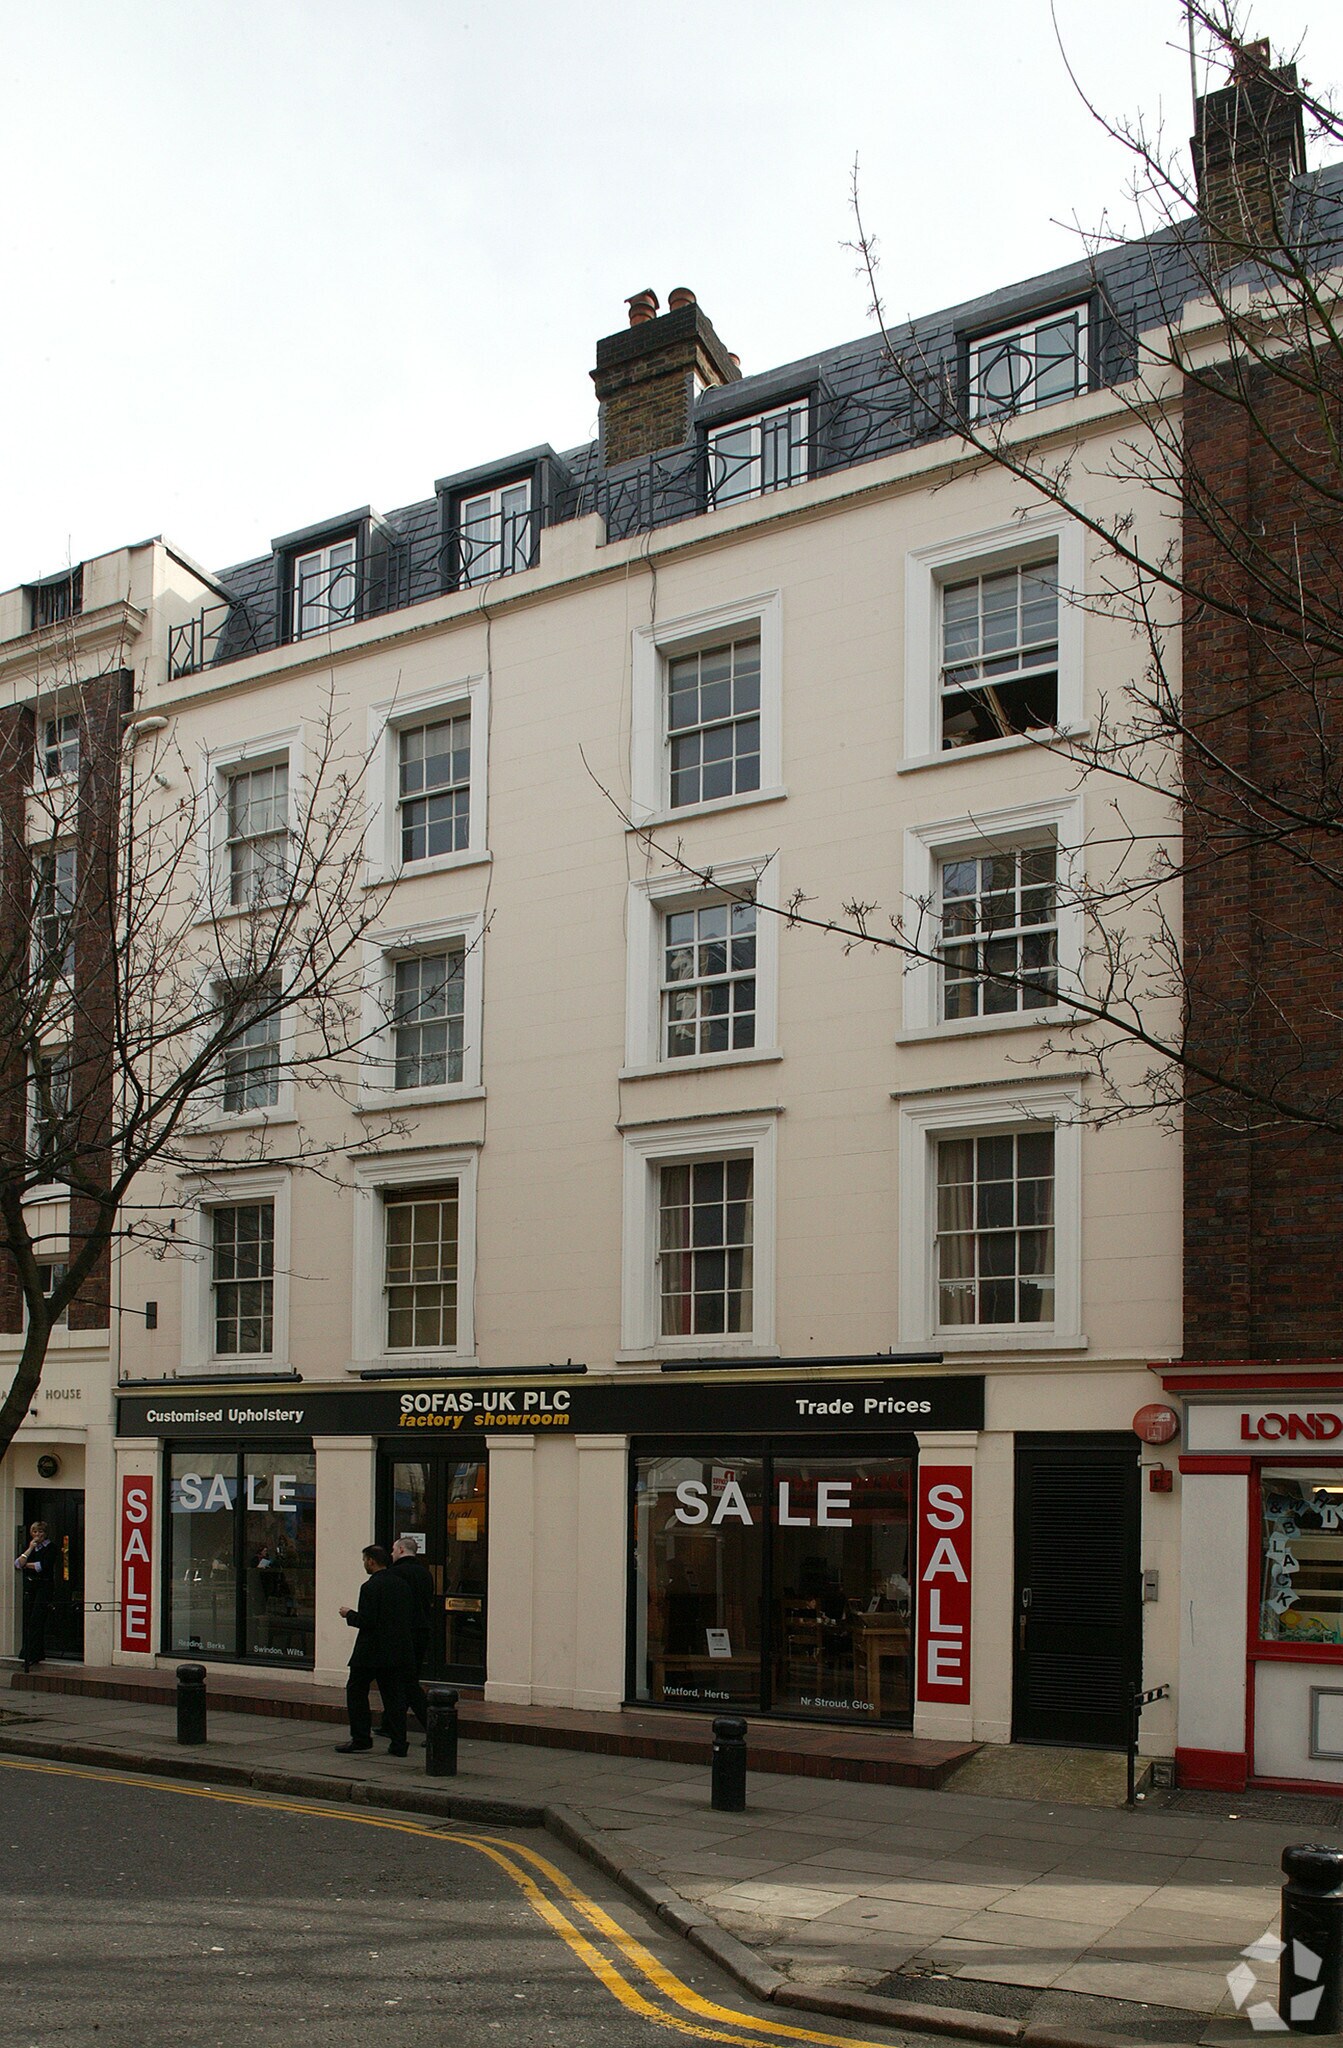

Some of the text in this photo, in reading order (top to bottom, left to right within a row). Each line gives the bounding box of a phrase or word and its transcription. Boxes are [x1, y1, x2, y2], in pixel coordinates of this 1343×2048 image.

[46, 1389, 82, 1400] HOUSE
[400, 1390, 571, 1413] SOFAS-UK PLC
[795, 1397, 932, 1415] Trade Prices
[146, 1408, 304, 1424] Customised Upholstery
[399, 1412, 570, 1429] factory showroom
[179, 1472, 297, 1512] SALE
[674, 1479, 853, 1528] SALE
[123, 1488, 150, 1639] SALE
[922, 1484, 968, 1686] SALE
[206, 1640, 225, 1650] Berks
[253, 1645, 304, 1657] Swindon, Wilts
[662, 1685, 730, 1700] Watford, Herts
[800, 1696, 875, 1710] Nr Stroud, Glos
